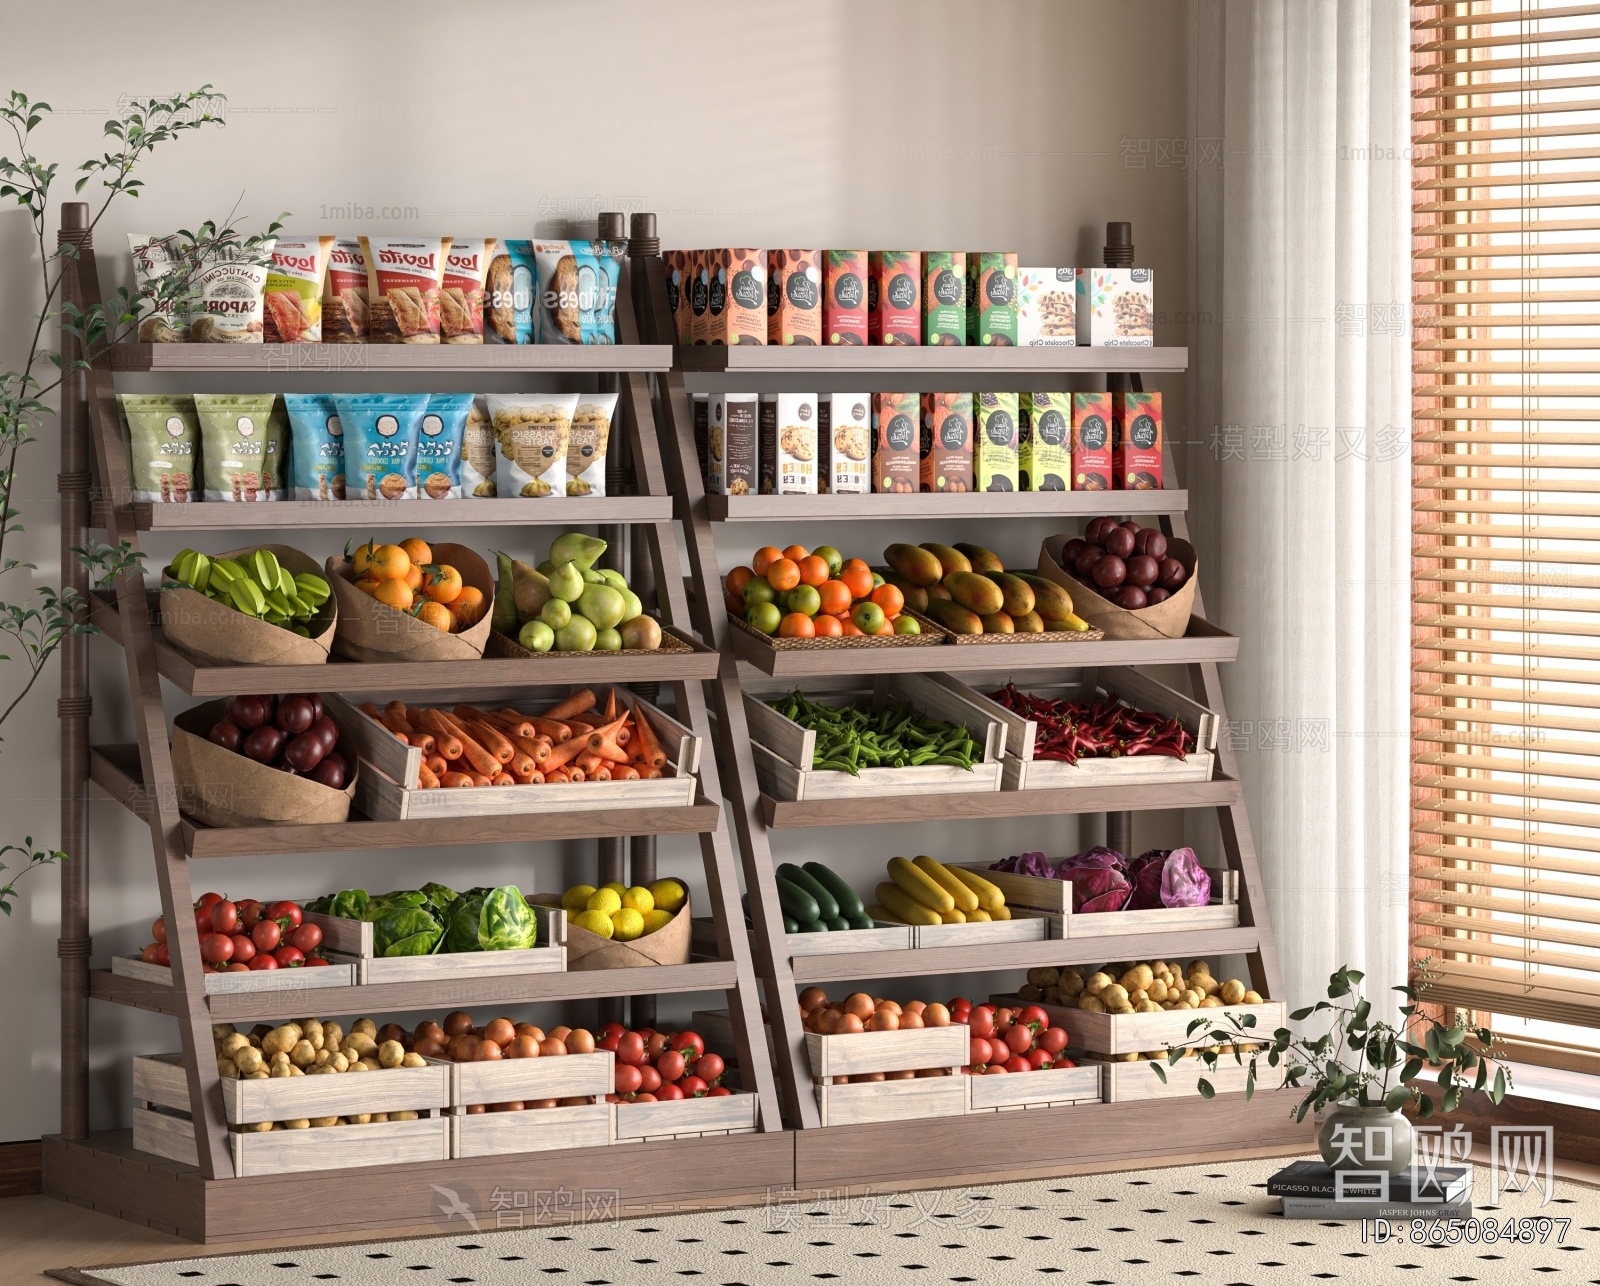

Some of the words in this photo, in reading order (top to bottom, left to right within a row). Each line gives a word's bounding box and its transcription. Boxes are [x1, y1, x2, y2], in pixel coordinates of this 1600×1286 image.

[1272, 1183, 1309, 1192] PICASSO
[1311, 1185, 1339, 1193] BLACK
[1379, 1209, 1409, 1217] JASPER
[1410, 1209, 1437, 1217] JOHNS
[1438, 1209, 1460, 1217] GRAY
